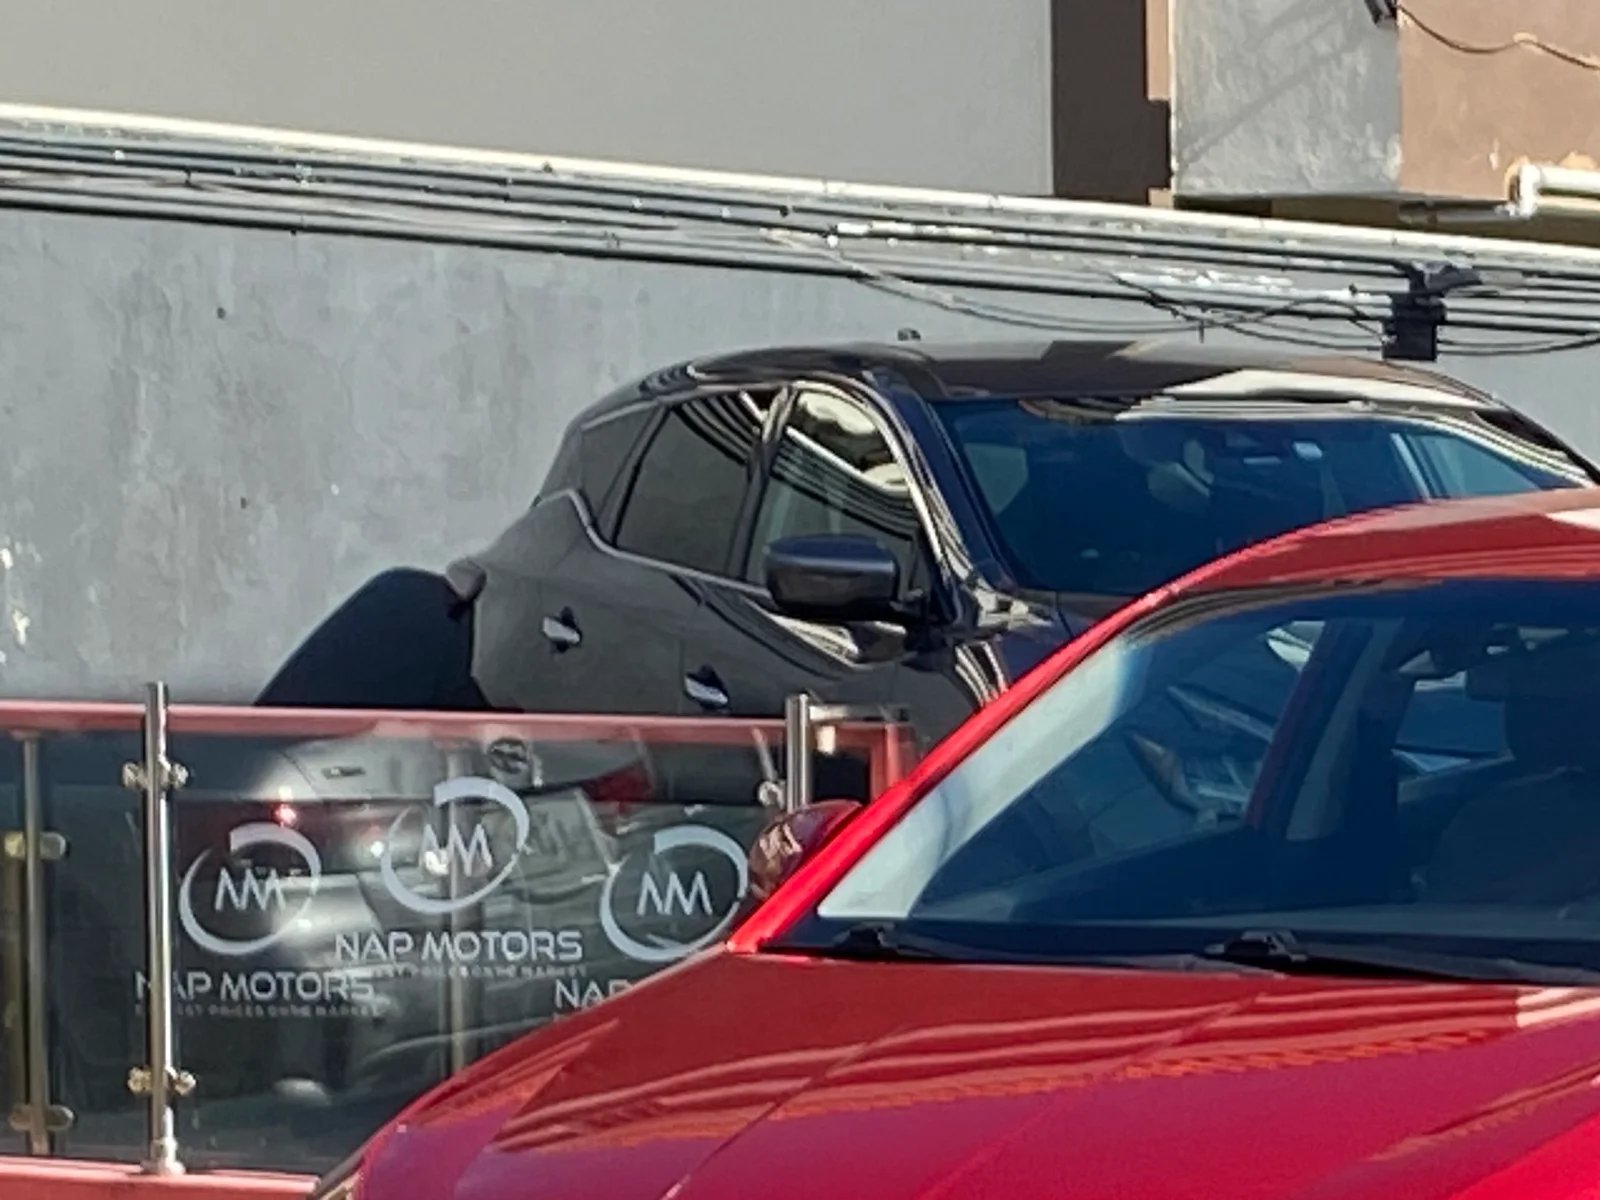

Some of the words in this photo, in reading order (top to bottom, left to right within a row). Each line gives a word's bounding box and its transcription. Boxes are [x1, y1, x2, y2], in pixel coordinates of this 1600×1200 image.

[334, 931, 413, 961] NAP
[421, 931, 583, 961] MOTORS
[220, 971, 376, 1000] MOTORS
